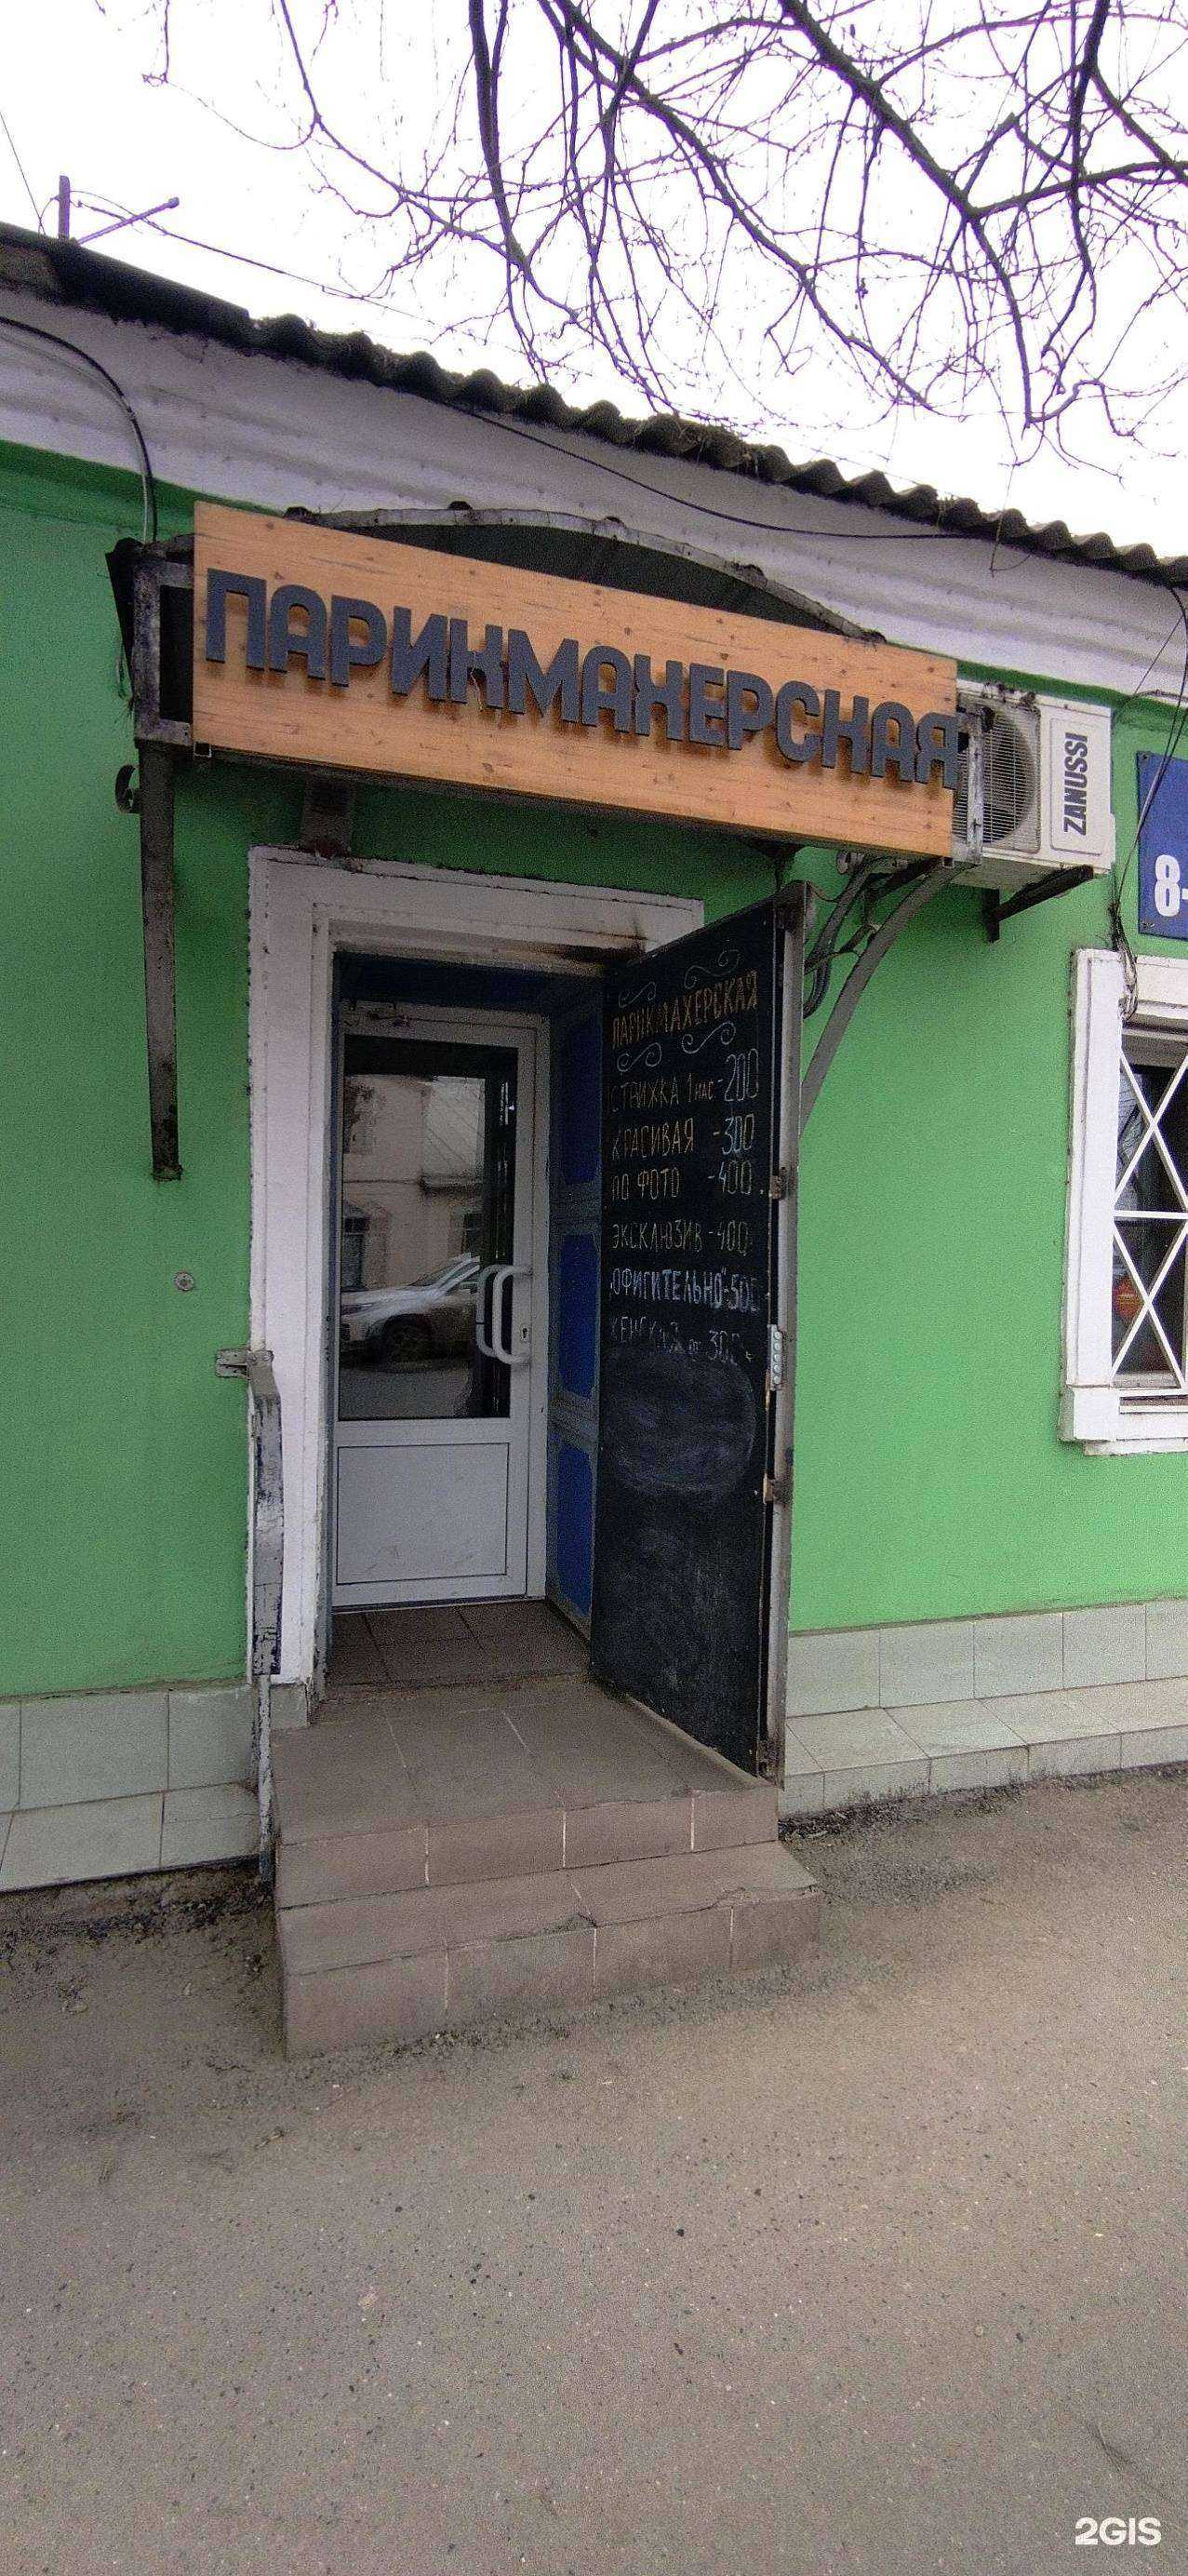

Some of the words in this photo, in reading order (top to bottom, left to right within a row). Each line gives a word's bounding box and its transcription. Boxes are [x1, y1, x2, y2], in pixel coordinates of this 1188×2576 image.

[206, 569, 958, 790] ПАРИКМАХЕРСКАЯ
[1063, 731, 1088, 836] ZANUSSI
[611, 969, 759, 1050] ПАРИКМАХЕРСКАЯ
[611, 1117, 694, 1161] КРАСИВАЯ
[611, 1173, 629, 1201] ПО
[637, 1166, 680, 1201] ФОТО
[611, 1218, 702, 1253] ЭКСКЛЮЗИВ
